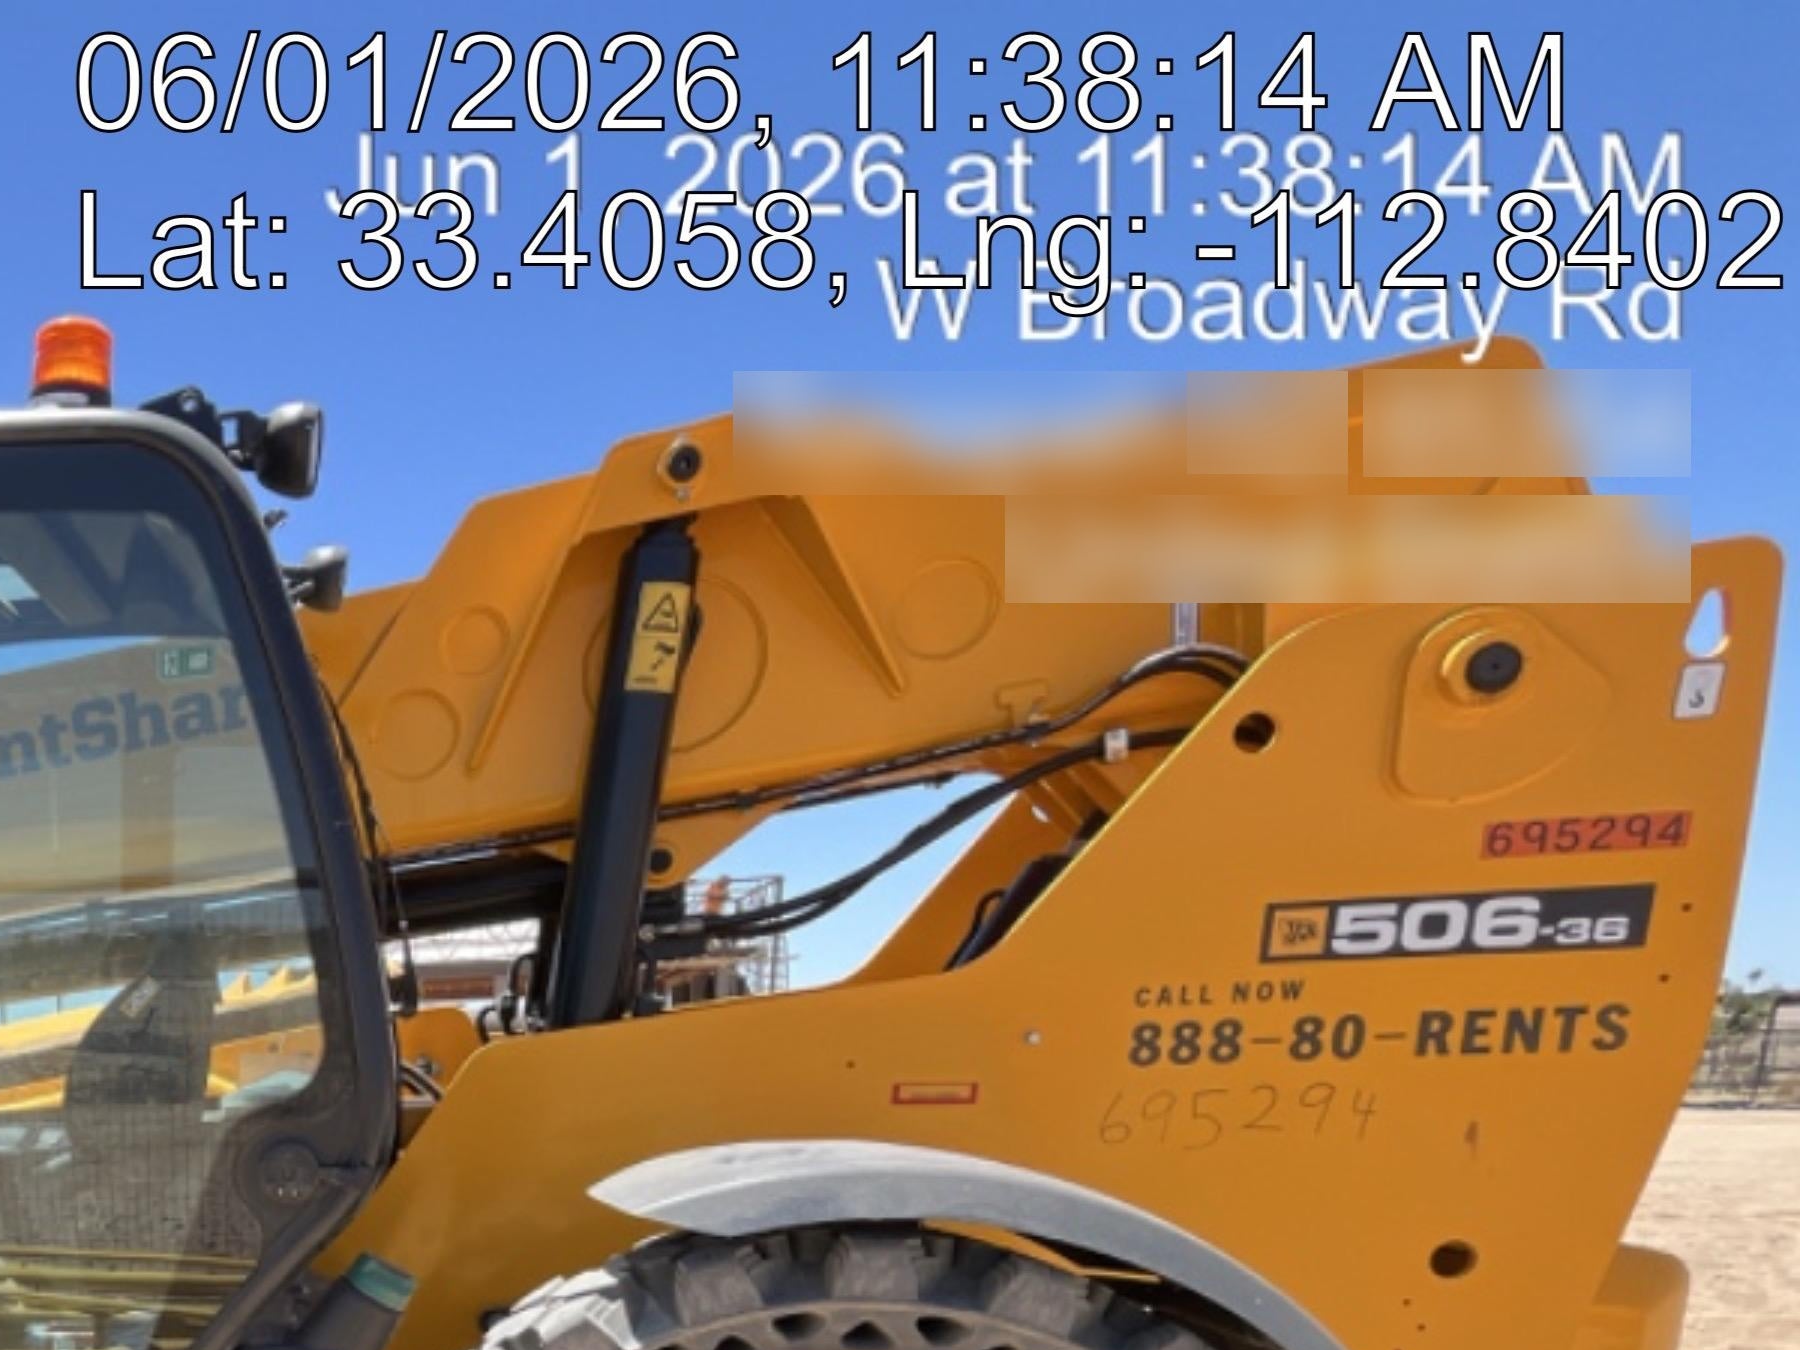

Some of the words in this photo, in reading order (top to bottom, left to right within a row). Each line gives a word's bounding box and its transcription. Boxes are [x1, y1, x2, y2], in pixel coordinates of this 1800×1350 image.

[1485, 811, 1687, 859] 695294
[1330, 896, 1631, 955] 506-36
[1133, 983, 1213, 1008] CALL
[1230, 978, 1305, 1003] NOW
[1127, 1003, 1632, 1068] 888-80-RENTS
[1099, 1081, 1378, 1151] 695294
